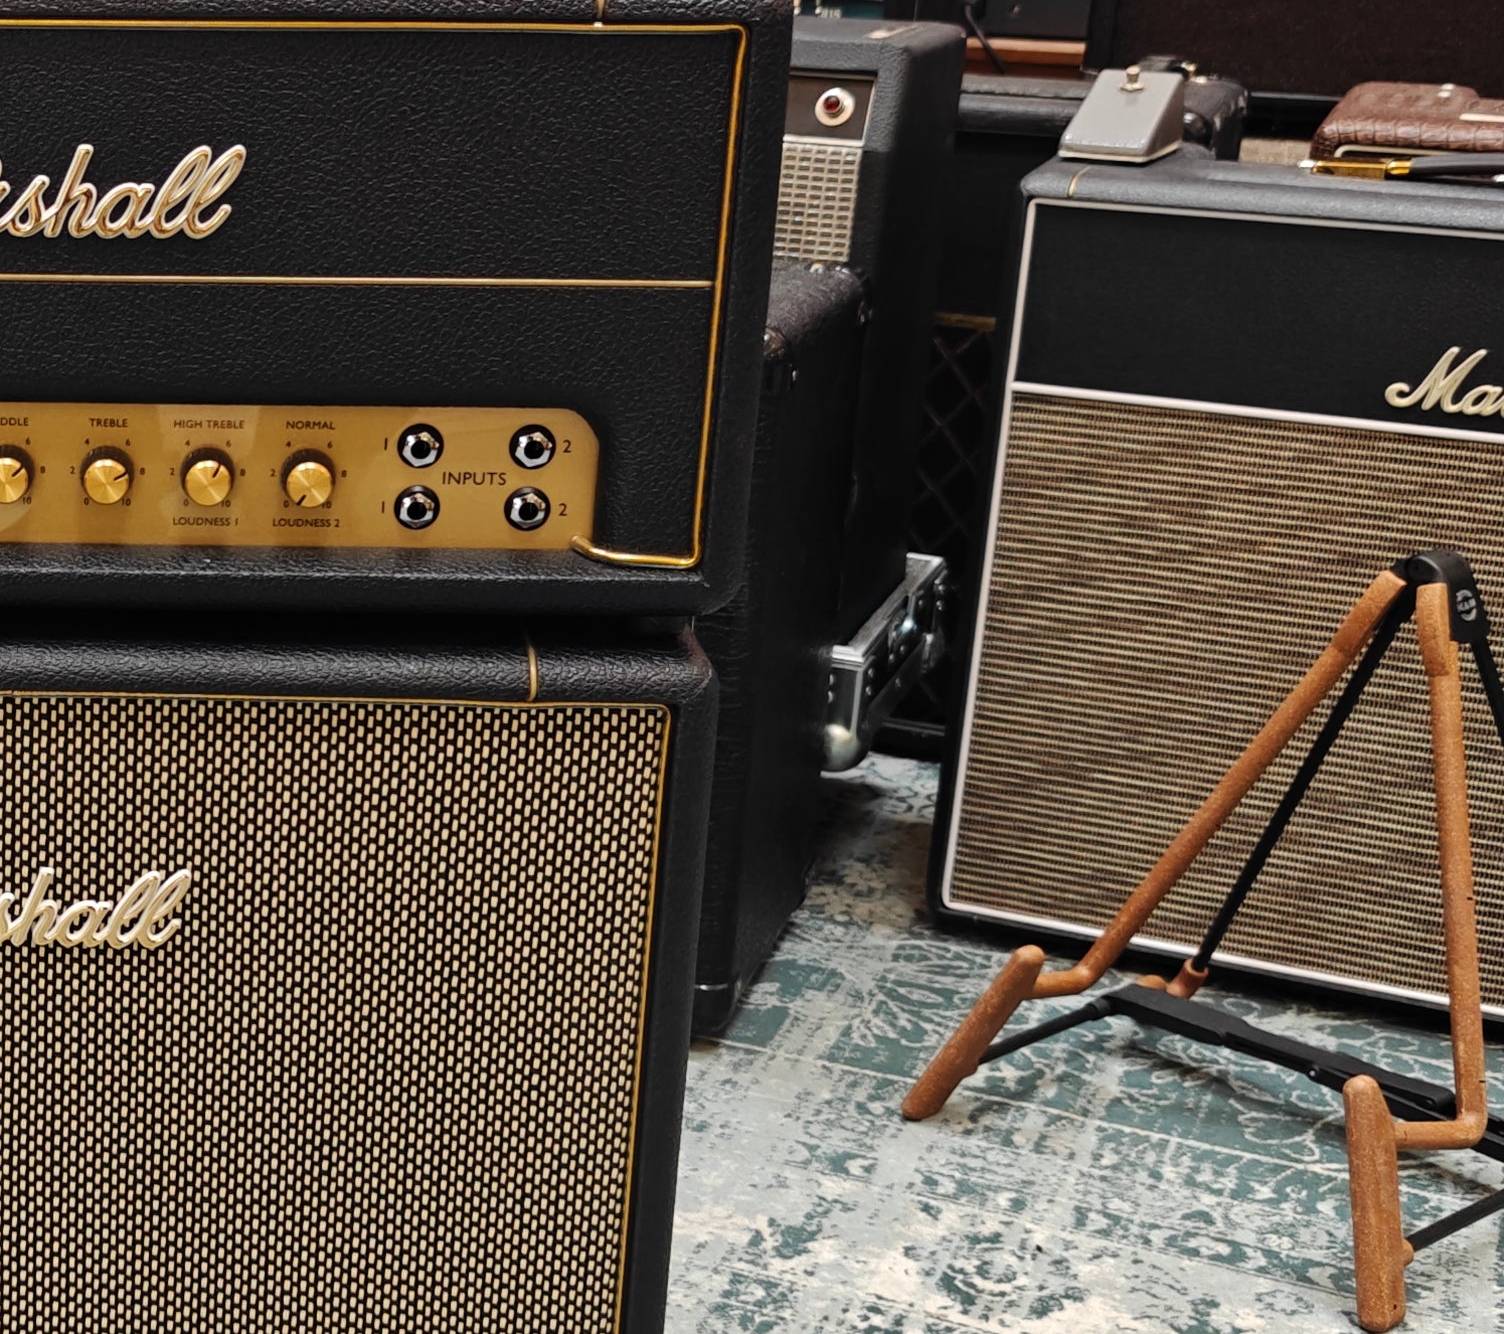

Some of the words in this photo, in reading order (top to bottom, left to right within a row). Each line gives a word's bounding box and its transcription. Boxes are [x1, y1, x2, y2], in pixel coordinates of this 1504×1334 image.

[1384, 346, 1504, 418] Ma
[88, 418, 128, 428] TREBLE
[173, 420, 203, 429] HIGH
[206, 420, 245, 429] TREBLE
[286, 421, 335, 430] NORMAL
[25, 437, 31, 445] 6
[84, 438, 90, 446] 4
[125, 438, 131, 446] 6
[226, 440, 231, 448] 6
[327, 441, 333, 449] 6
[384, 437, 388, 451] 1
[562, 439, 572, 453] 2
[170, 468, 175, 476] 2
[270, 469, 276, 477] 2
[441, 471, 507, 485] INPUTS
[22, 497, 32, 505] 10
[121, 498, 131, 506] 10
[381, 501, 385, 513] 1
[558, 503, 568, 516] 2
[172, 517, 231, 526] LOUDNESS
[272, 518, 331, 527] LOUDNESS
[333, 519, 340, 528] 2
